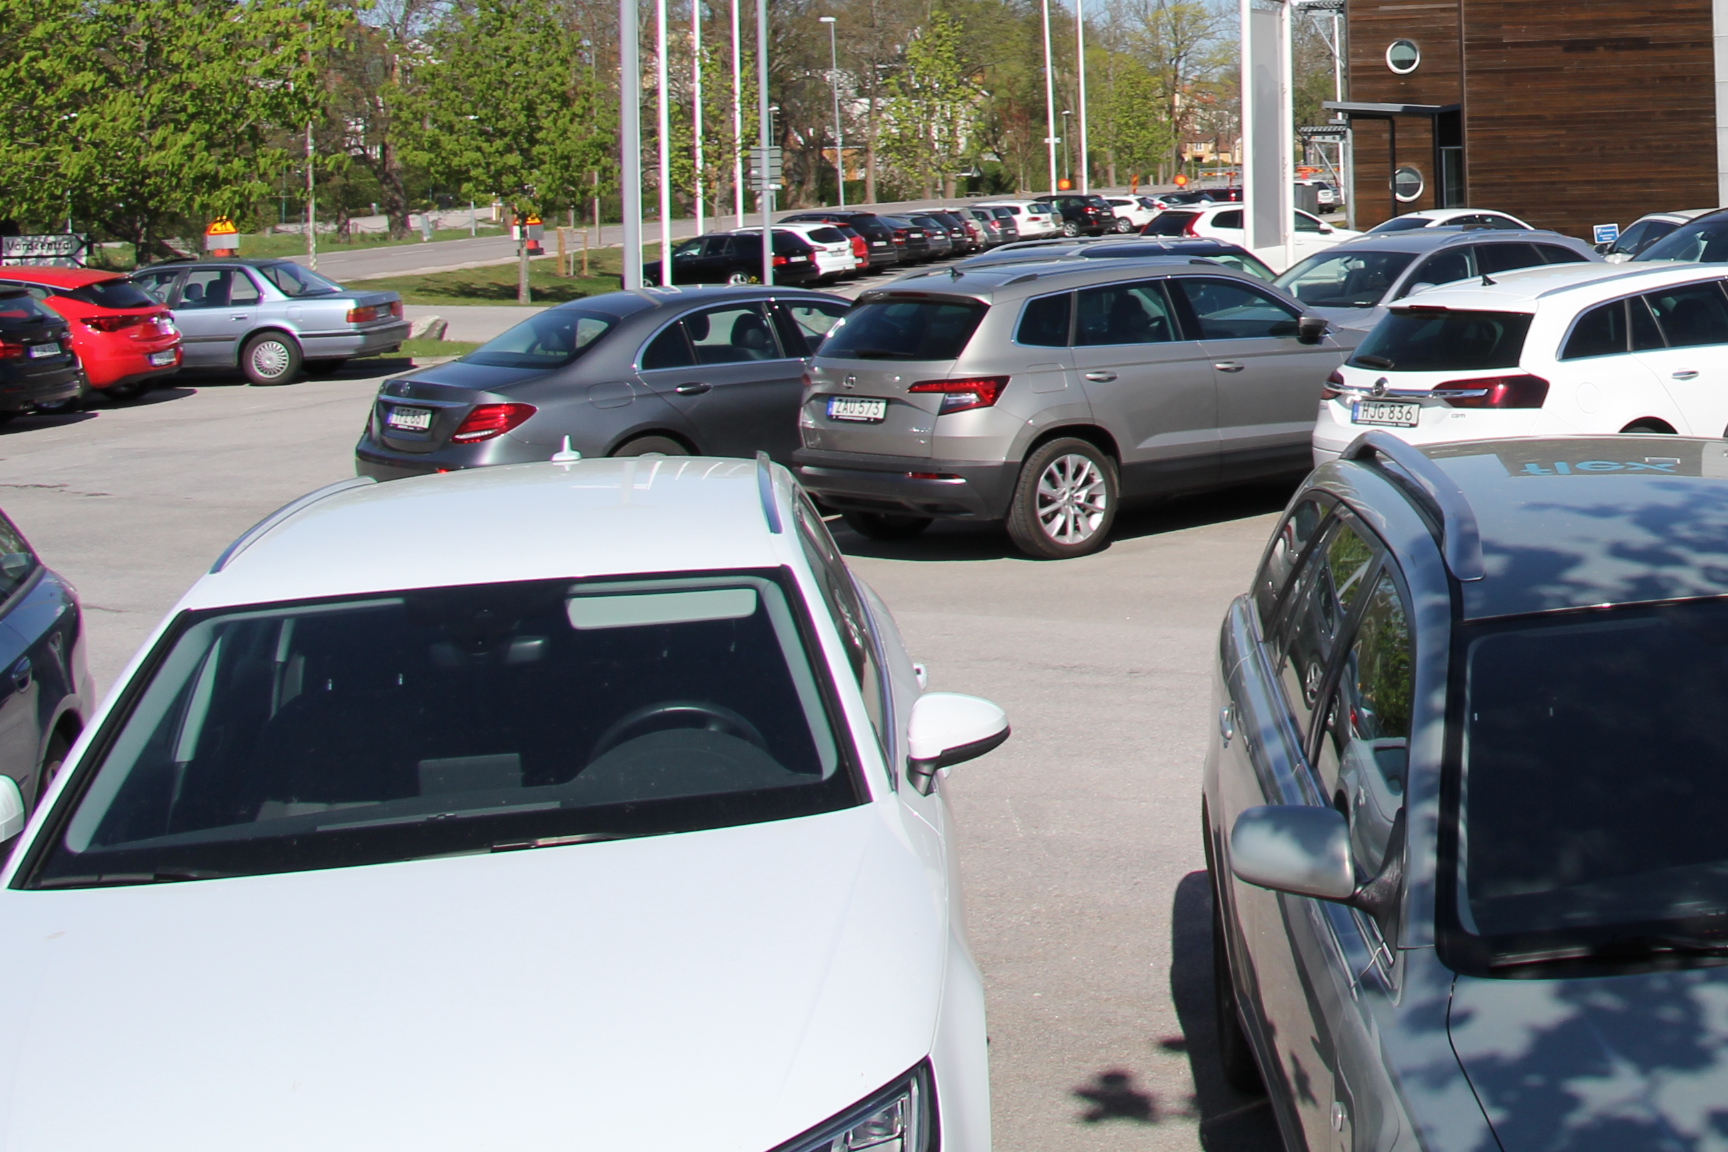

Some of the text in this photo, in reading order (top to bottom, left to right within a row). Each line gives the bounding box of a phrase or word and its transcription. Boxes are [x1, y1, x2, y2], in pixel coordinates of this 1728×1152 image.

[836, 397, 881, 416] ZAU 573
[1361, 400, 1413, 421] HJG 836
